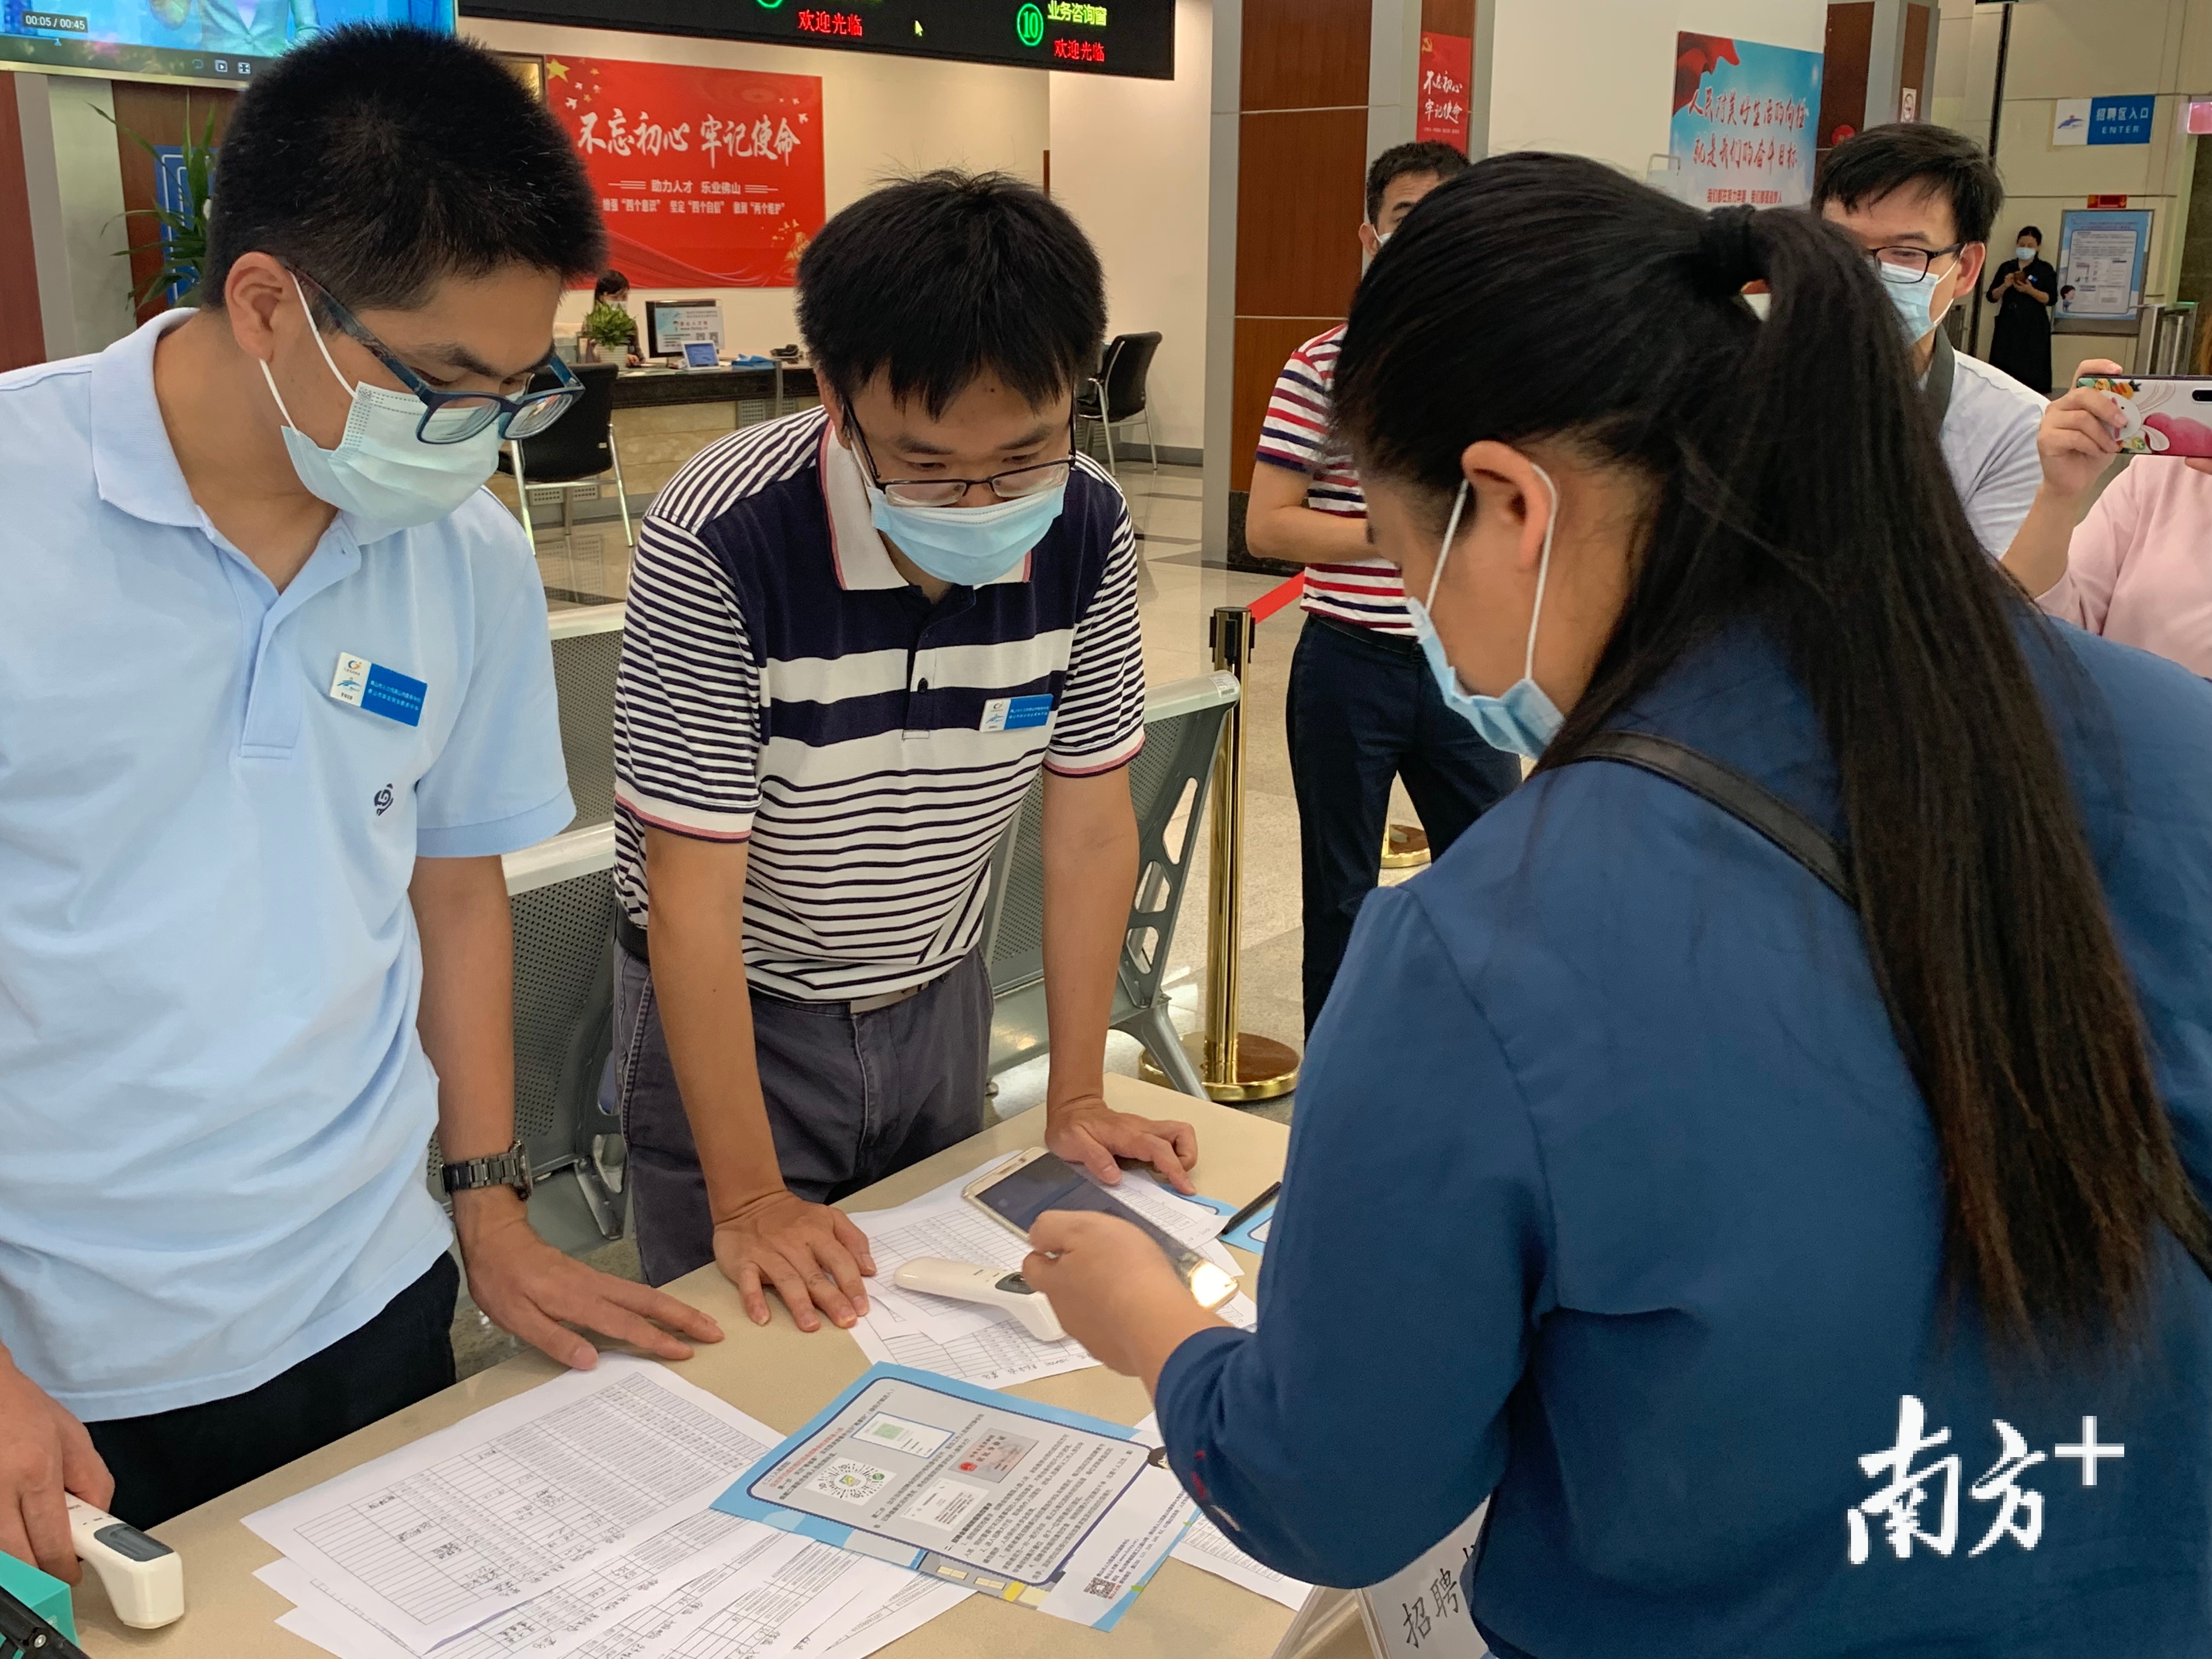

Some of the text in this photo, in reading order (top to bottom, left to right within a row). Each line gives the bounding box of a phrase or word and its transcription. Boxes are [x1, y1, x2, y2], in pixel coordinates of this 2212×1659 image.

[25, 15, 52, 26] 00:05
[60, 19, 86, 30] 00:45
[798, 9, 863, 37] 欢迎光临
[1023, 12, 1039, 38] 10
[1047, 1, 1107, 27] 业务咨询窗
[1054, 38, 1105, 63] 欢迎光临
[1423, 70, 1463, 95] 不忘初心
[1424, 98, 1463, 125] 牢记使命
[2096, 107, 2149, 122] 招聘区入口
[577, 108, 801, 169] 不忘初心 牢记使命
[2102, 125, 2140, 134] ENTER
[1694, 132, 1798, 176] 就是我们的奋斗目标
[651, 179, 742, 195] 助力人才 乐业佛山
